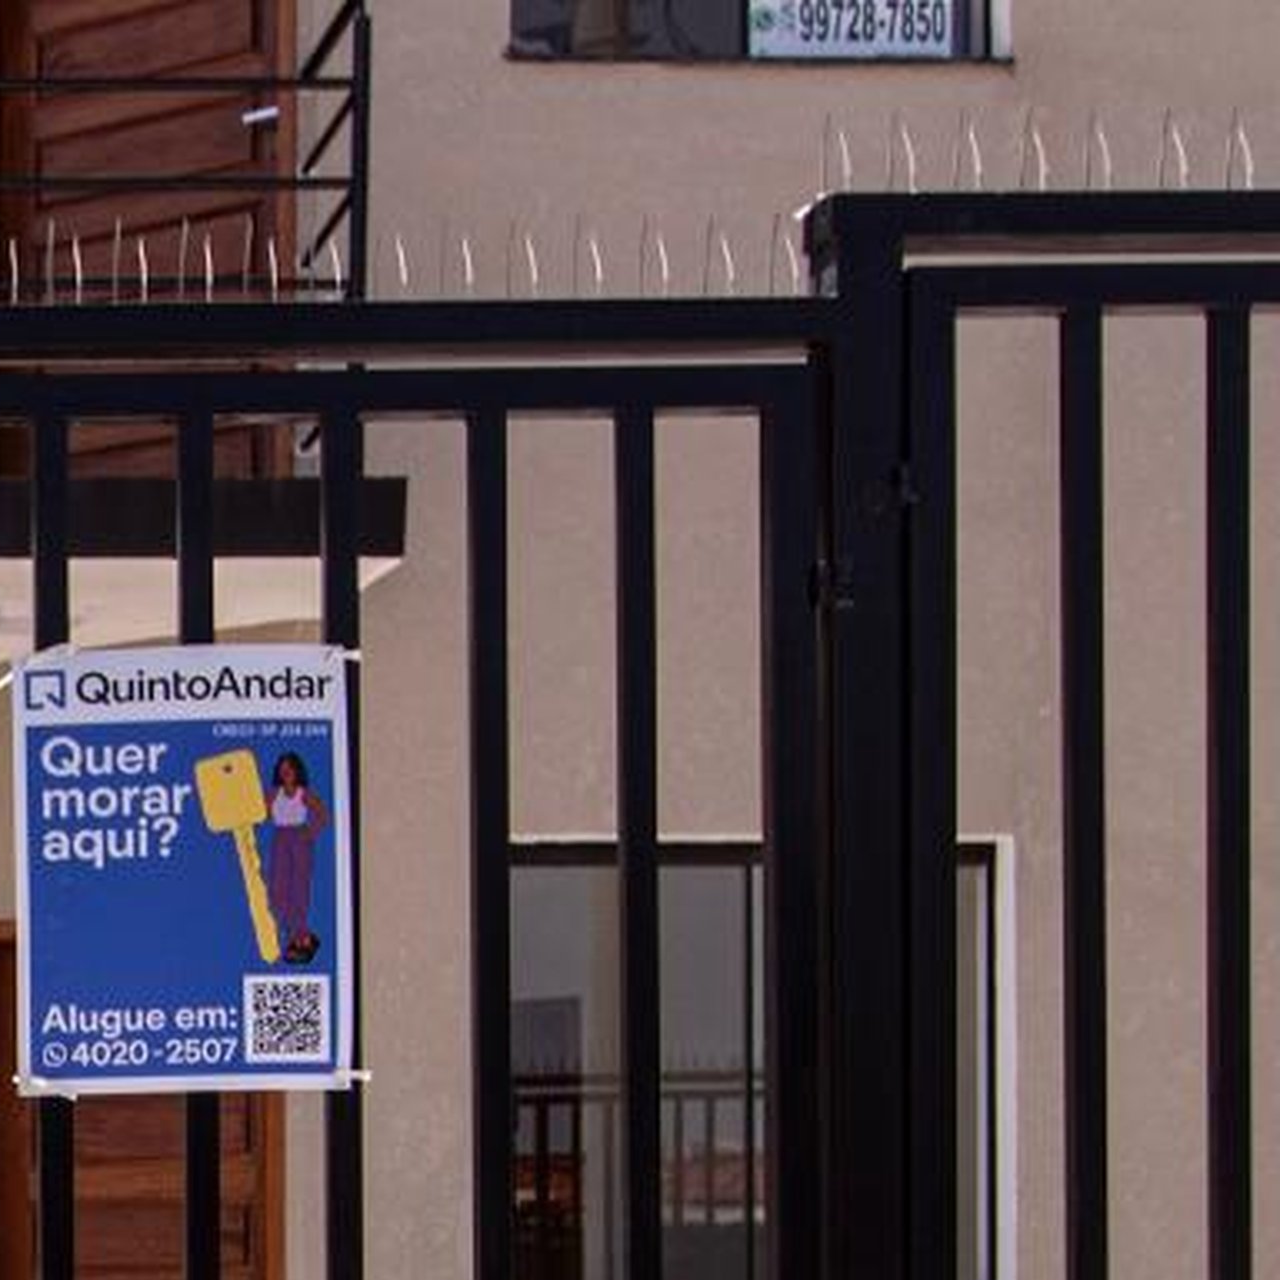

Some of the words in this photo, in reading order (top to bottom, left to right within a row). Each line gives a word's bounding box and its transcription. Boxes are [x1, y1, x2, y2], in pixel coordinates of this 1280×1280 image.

[799, 0, 944, 42] 99728-7850
[76, 667, 331, 705] QuintoAndar
[41, 737, 167, 777] Quer
[42, 783, 191, 819] morar
[42, 818, 178, 868] aqui?
[43, 1005, 166, 1038] Alugue
[175, 1007, 239, 1031] em:
